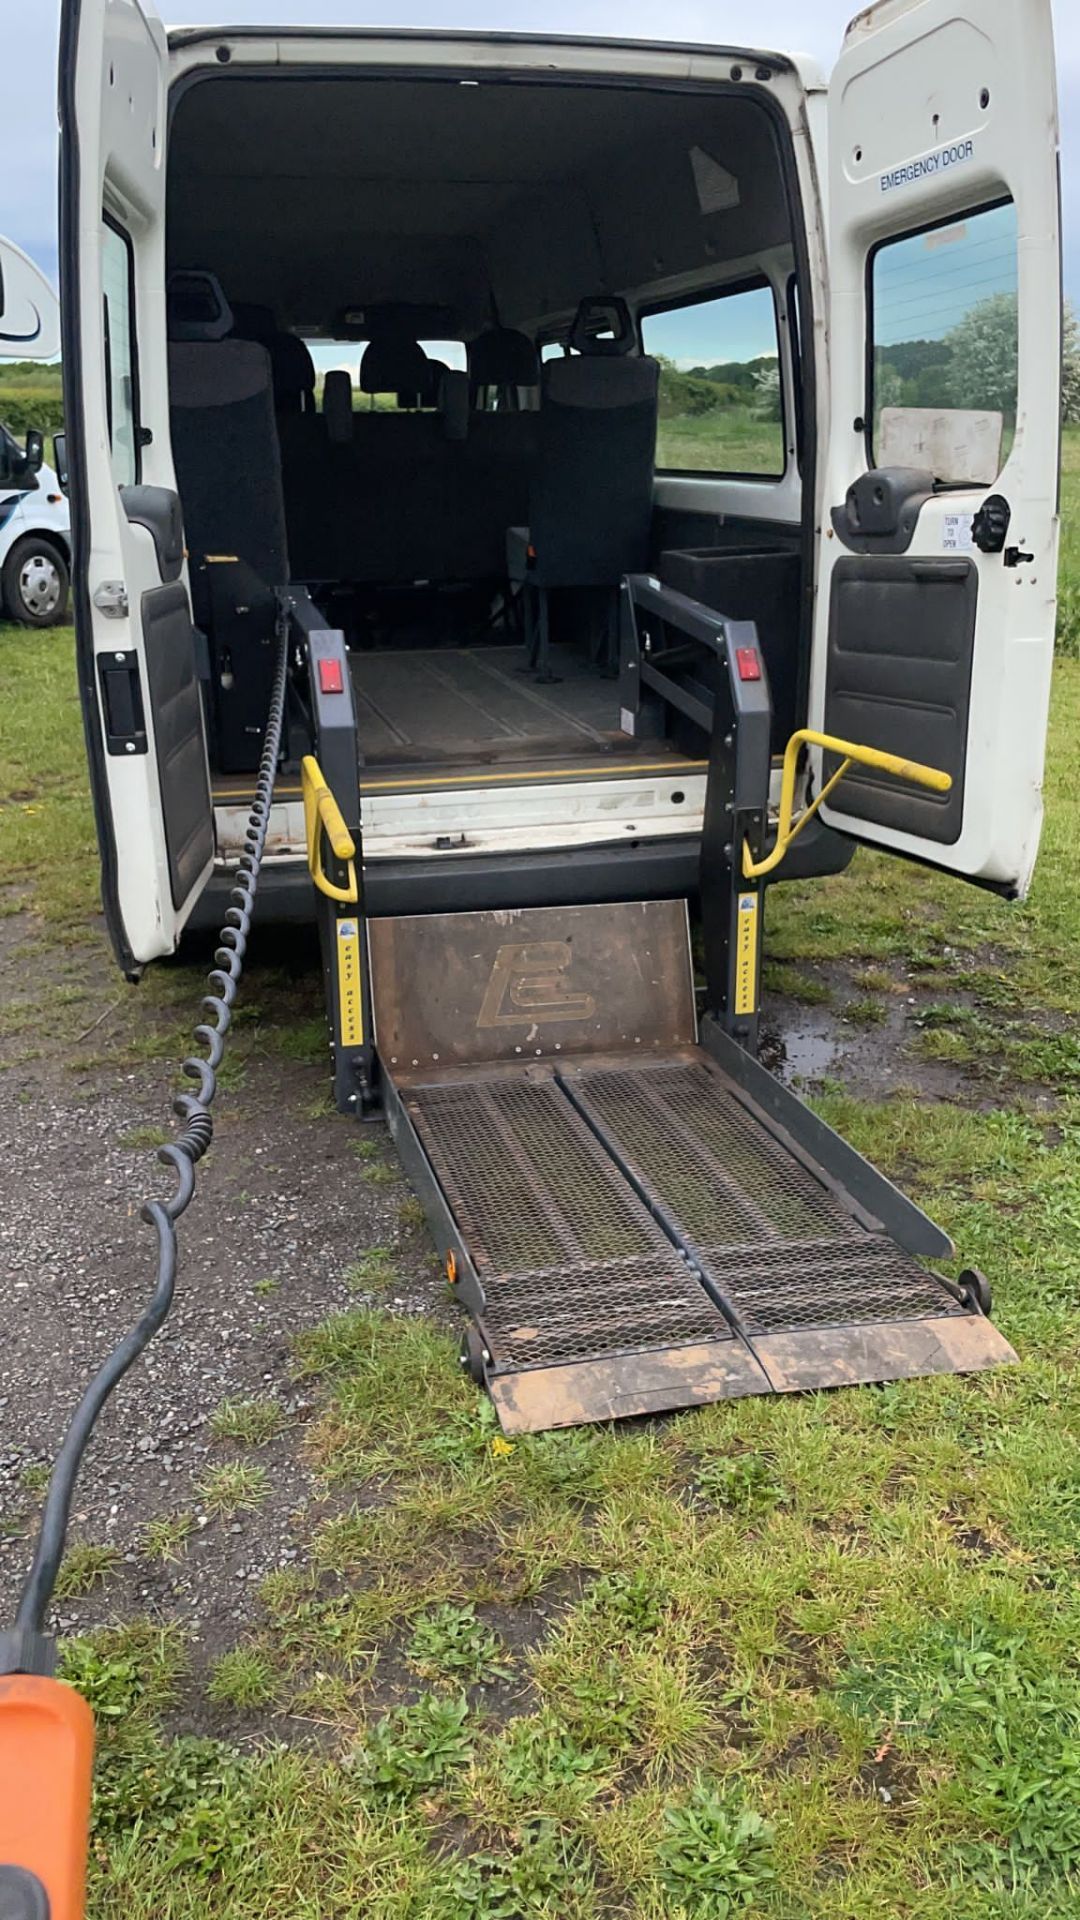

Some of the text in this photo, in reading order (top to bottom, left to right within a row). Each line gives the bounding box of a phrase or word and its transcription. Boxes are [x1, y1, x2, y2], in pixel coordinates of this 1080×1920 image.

[880, 140, 973, 191] EMERGENCY DOOR
[945, 516, 959, 526] TURN
[943, 539, 956, 549] OPEN
[345, 945, 355, 1040] easy access
